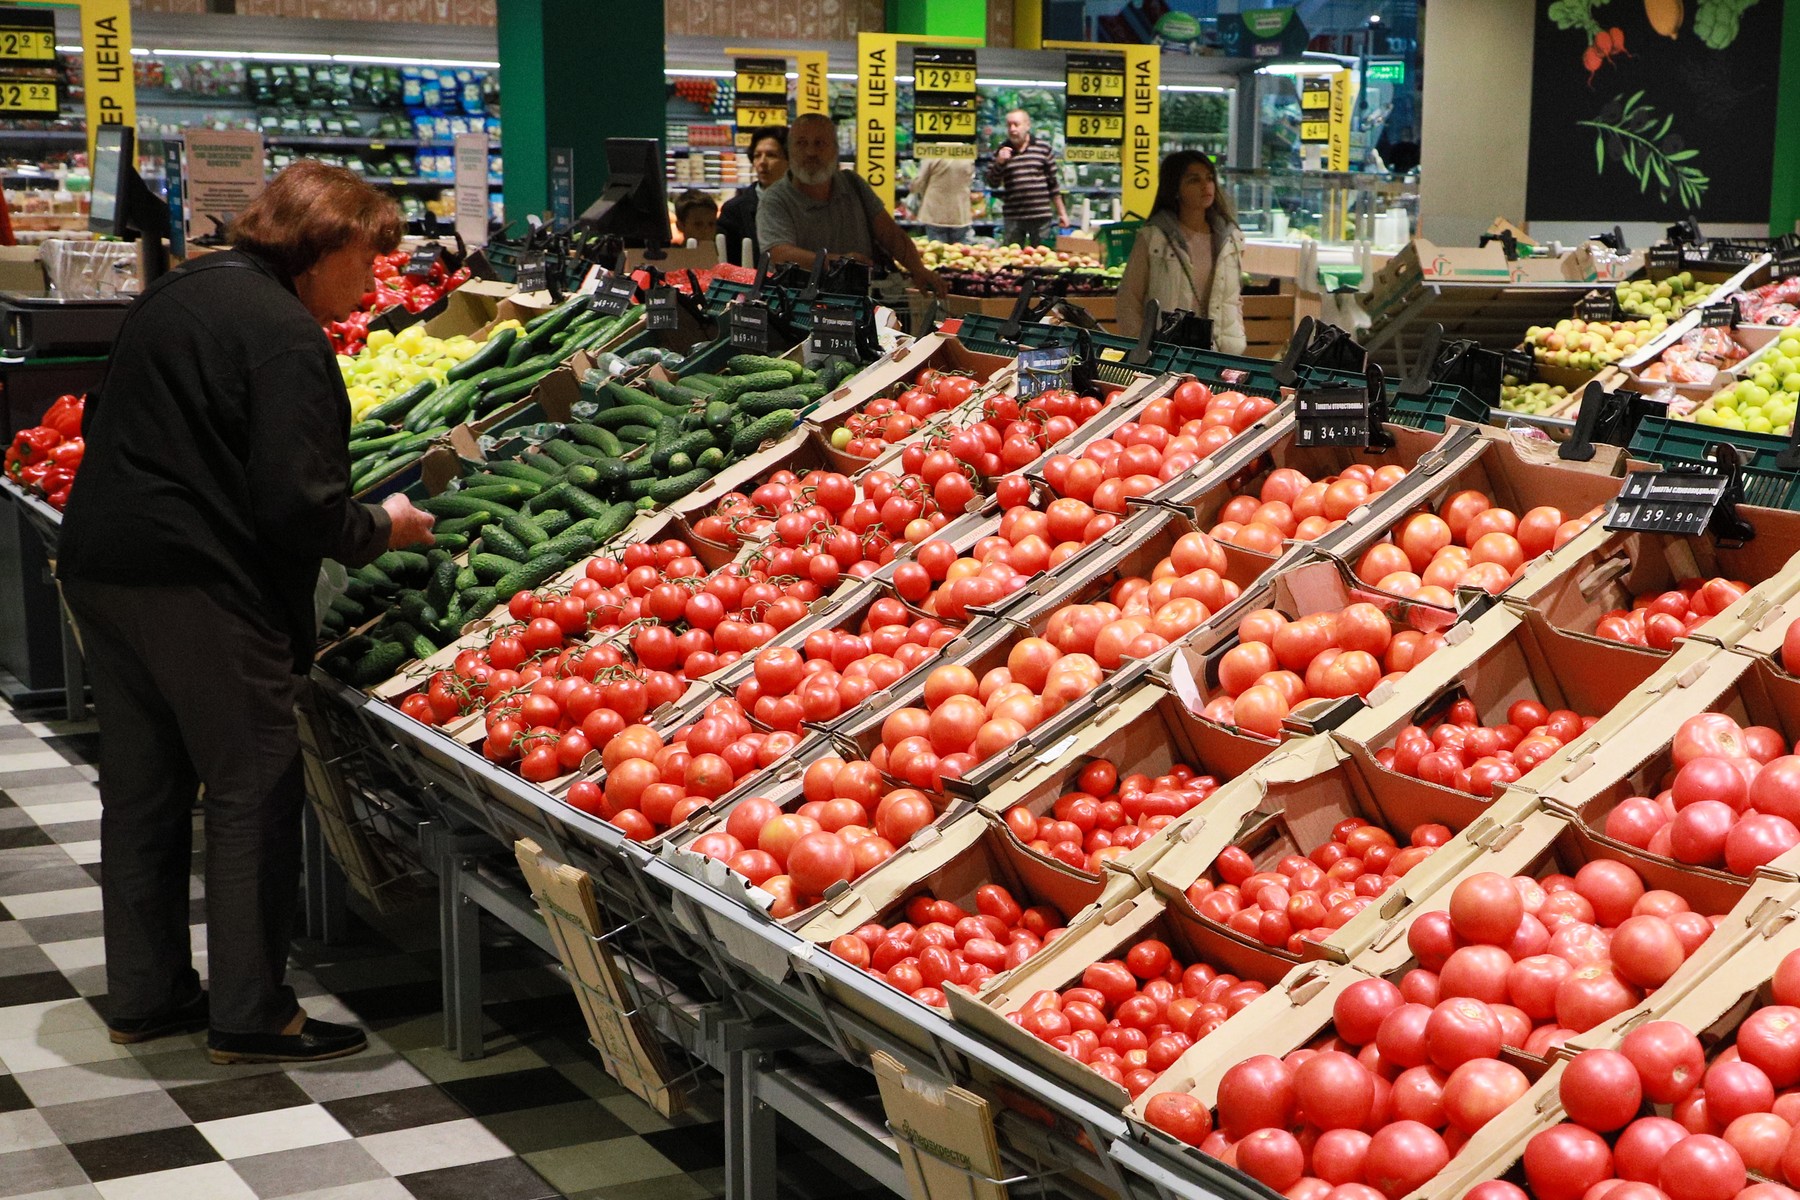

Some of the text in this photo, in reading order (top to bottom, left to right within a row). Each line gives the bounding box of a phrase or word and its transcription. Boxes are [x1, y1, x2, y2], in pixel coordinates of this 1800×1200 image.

[0, 35, 18, 54] 2
[95, 16, 124, 82] ЦЕНА
[748, 76, 766, 89] 79
[806, 63, 824, 110] ЦЕНА
[919, 70, 951, 88] 129
[1081, 76, 1101, 93] 89
[748, 110, 767, 124] 79
[868, 49, 888, 186] СУПЕР ЦЕНА
[918, 114, 952, 131] 129
[1134, 60, 1153, 190] СУПЕР ЦЕНА
[1332, 80, 1344, 171] УПЕР ЦЕНА
[1080, 118, 1100, 134] 89
[915, 146, 975, 157] СУПЕР ЦЕНА
[1066, 149, 1121, 160] СУПЕР ЦЕНА
[1650, 485, 1672, 493] Томаты
